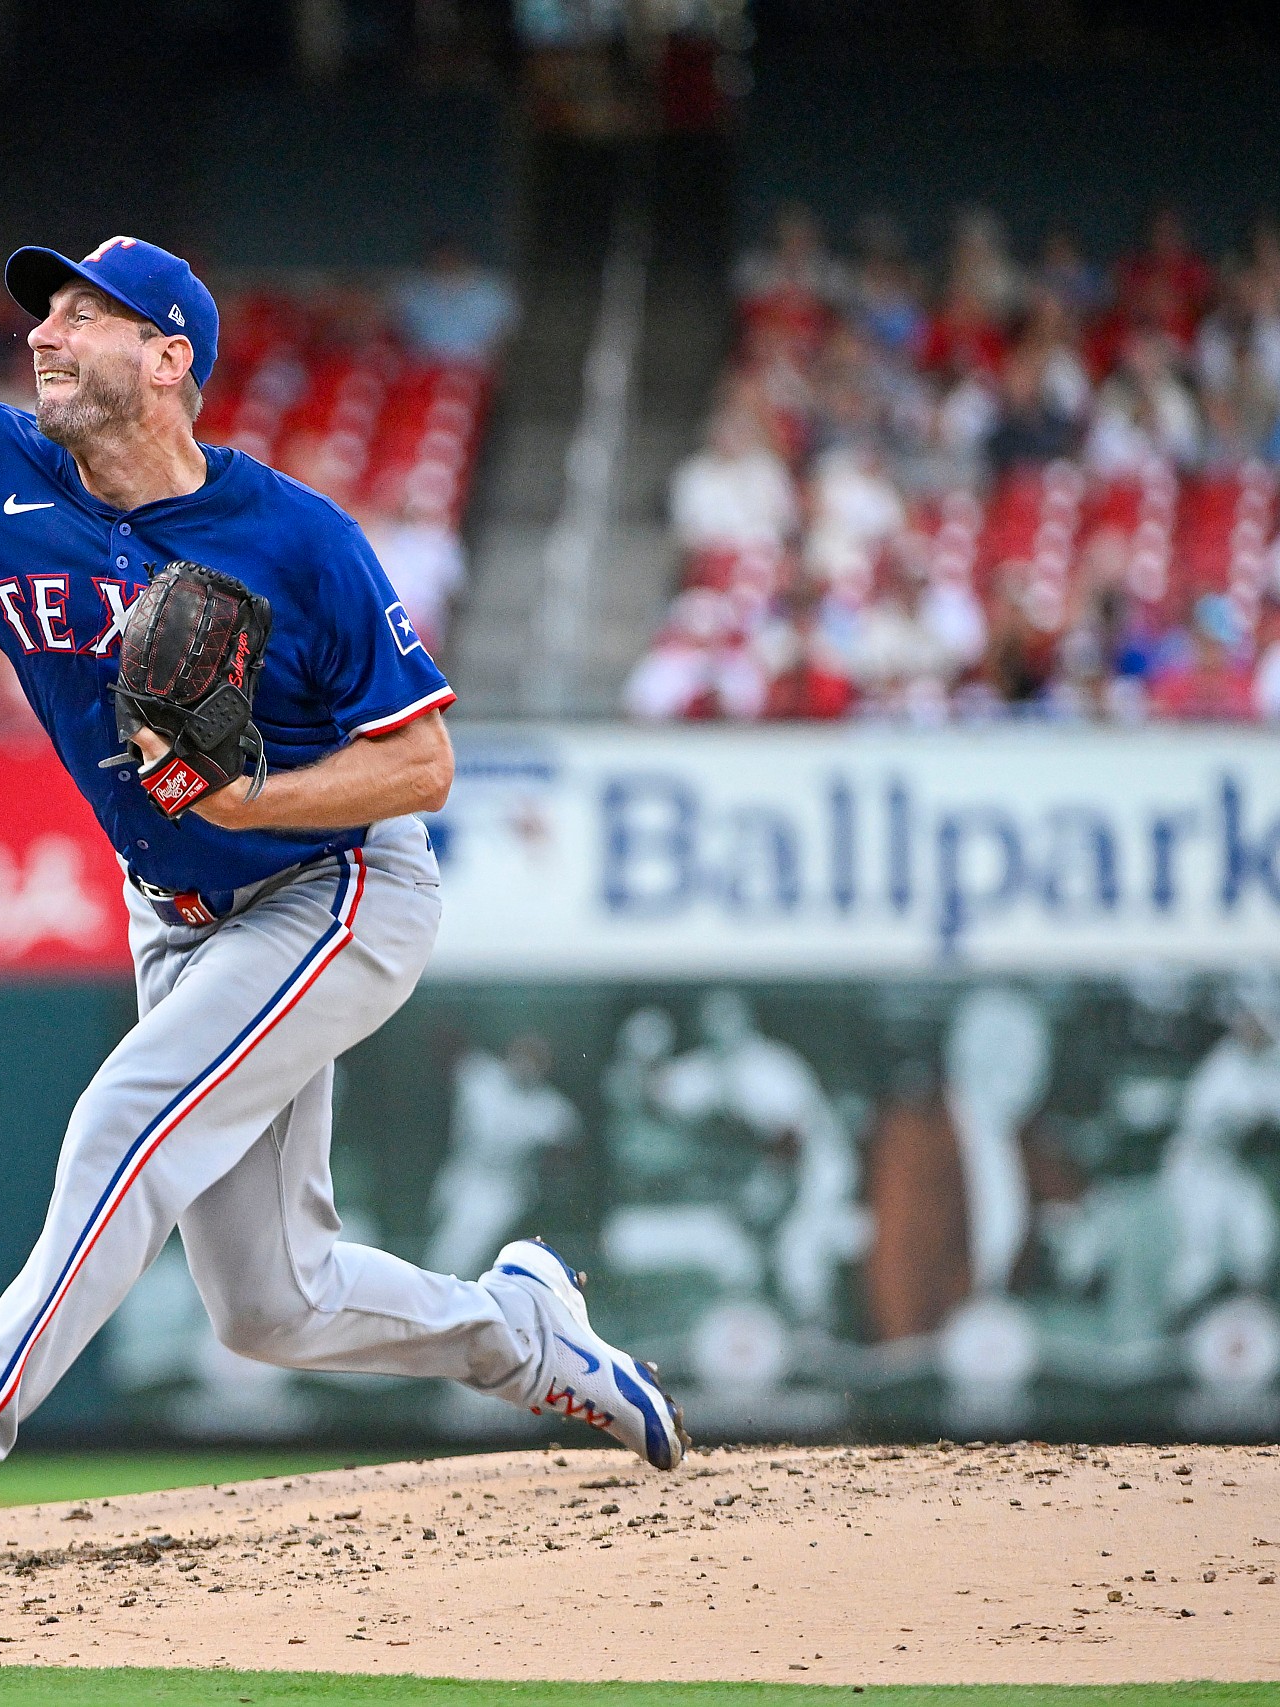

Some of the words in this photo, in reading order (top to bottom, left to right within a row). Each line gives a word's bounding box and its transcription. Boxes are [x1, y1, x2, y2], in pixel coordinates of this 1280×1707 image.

[155, 770, 188, 802] Rawlings
[594, 766, 1280, 958] Ballpark
[181, 906, 207, 924] 31
